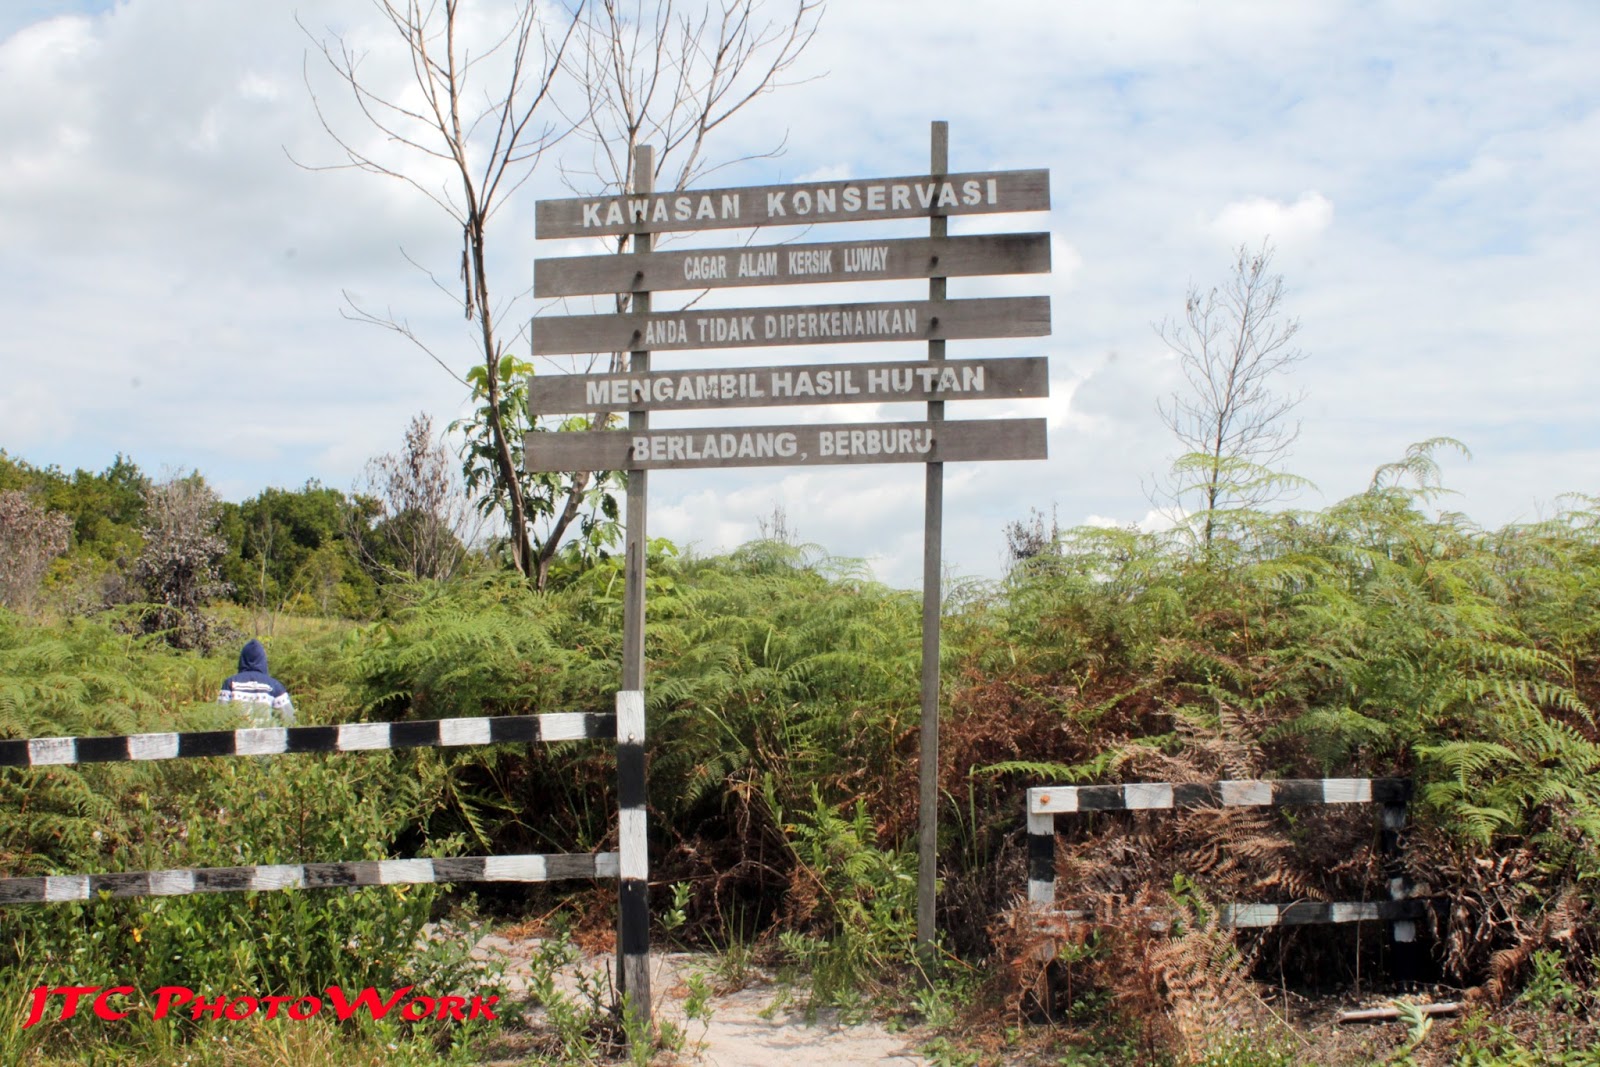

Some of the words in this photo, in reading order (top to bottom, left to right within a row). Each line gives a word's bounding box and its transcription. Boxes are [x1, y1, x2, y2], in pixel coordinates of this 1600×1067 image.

[582, 193, 740, 228] KAWASAN
[767, 179, 998, 217] KONSERVASI
[684, 254, 727, 280] CAGAR
[738, 252, 778, 277] ALAM
[788, 249, 832, 275] KERSIK
[844, 247, 889, 272] LUWAY
[645, 318, 688, 344] ANDA
[698, 316, 756, 342] TIDAK
[765, 308, 917, 339] DIPERKENANKAN
[586, 373, 765, 405] MENGAMBIL
[771, 370, 860, 397] HASIL
[868, 366, 985, 393] HUTAN
[632, 432, 808, 461] BERLADANG,
